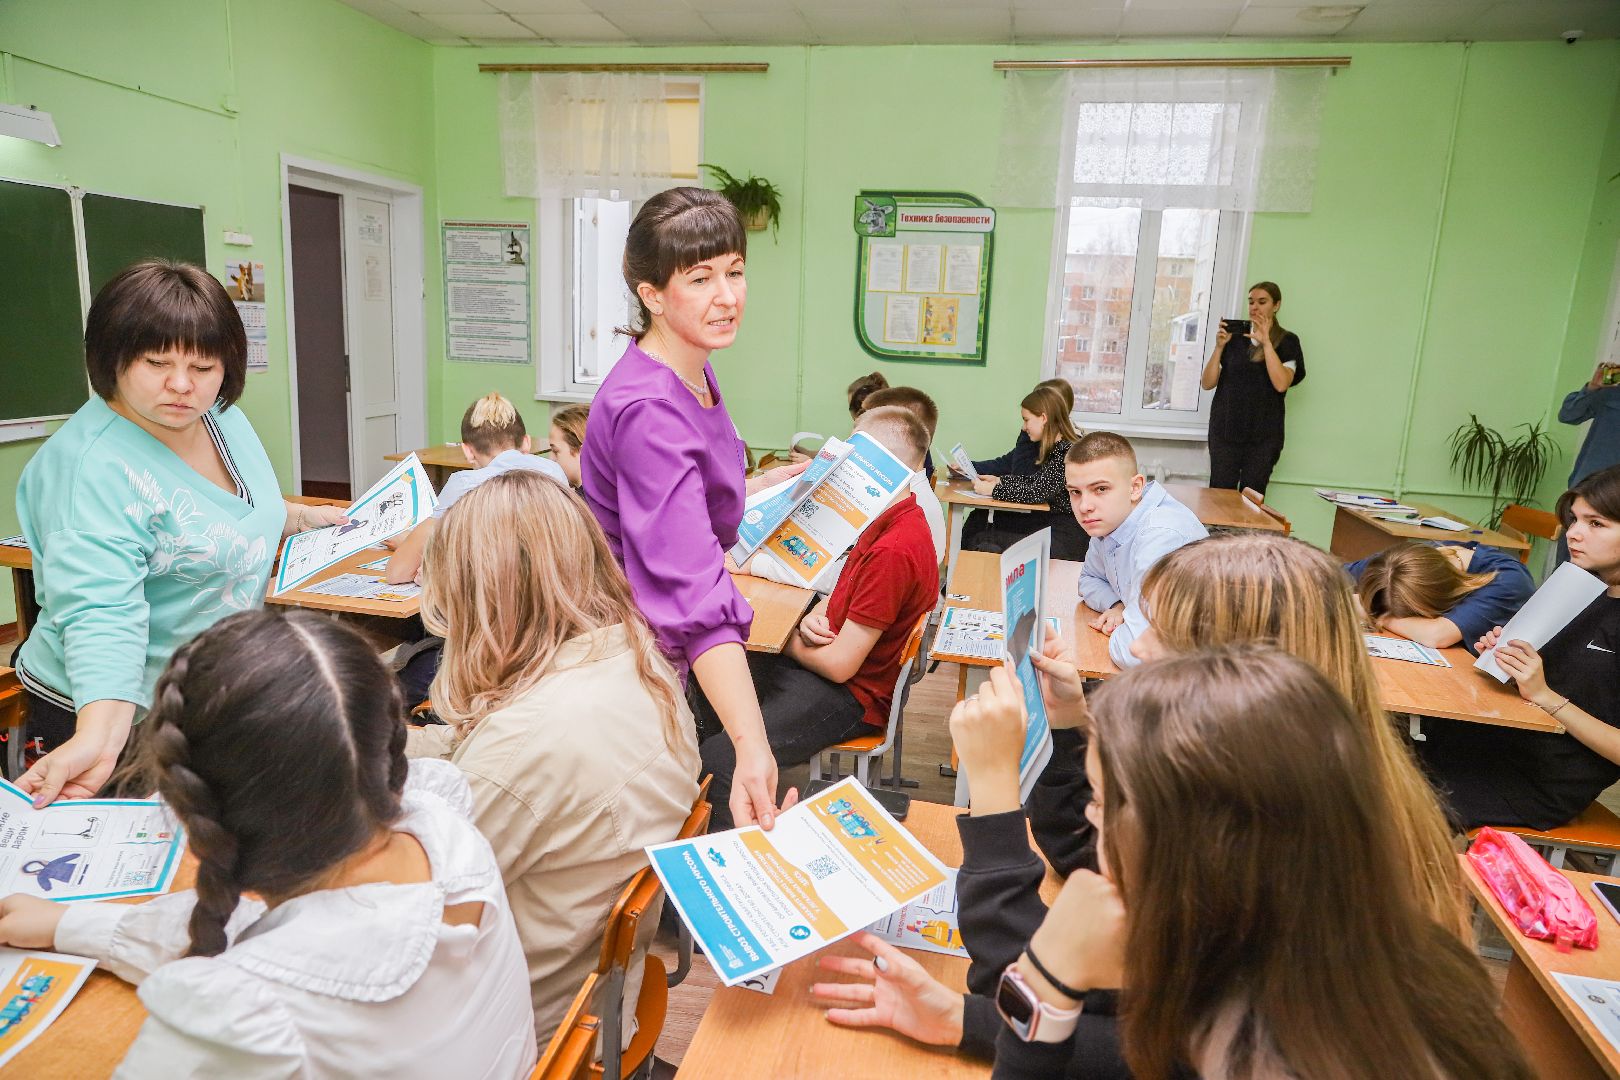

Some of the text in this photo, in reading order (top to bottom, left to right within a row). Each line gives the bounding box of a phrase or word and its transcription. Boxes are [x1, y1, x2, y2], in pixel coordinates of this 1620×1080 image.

[900, 213, 990, 224] Техника безопасности
[0, 828, 15, 848] вещи
[11, 826, 29, 849] даром
[679, 850, 705, 880] МУСОРА
[697, 878, 742, 937] СТРОИТЕЛЬНОГО
[736, 935, 760, 962] ВЫВОЗ
